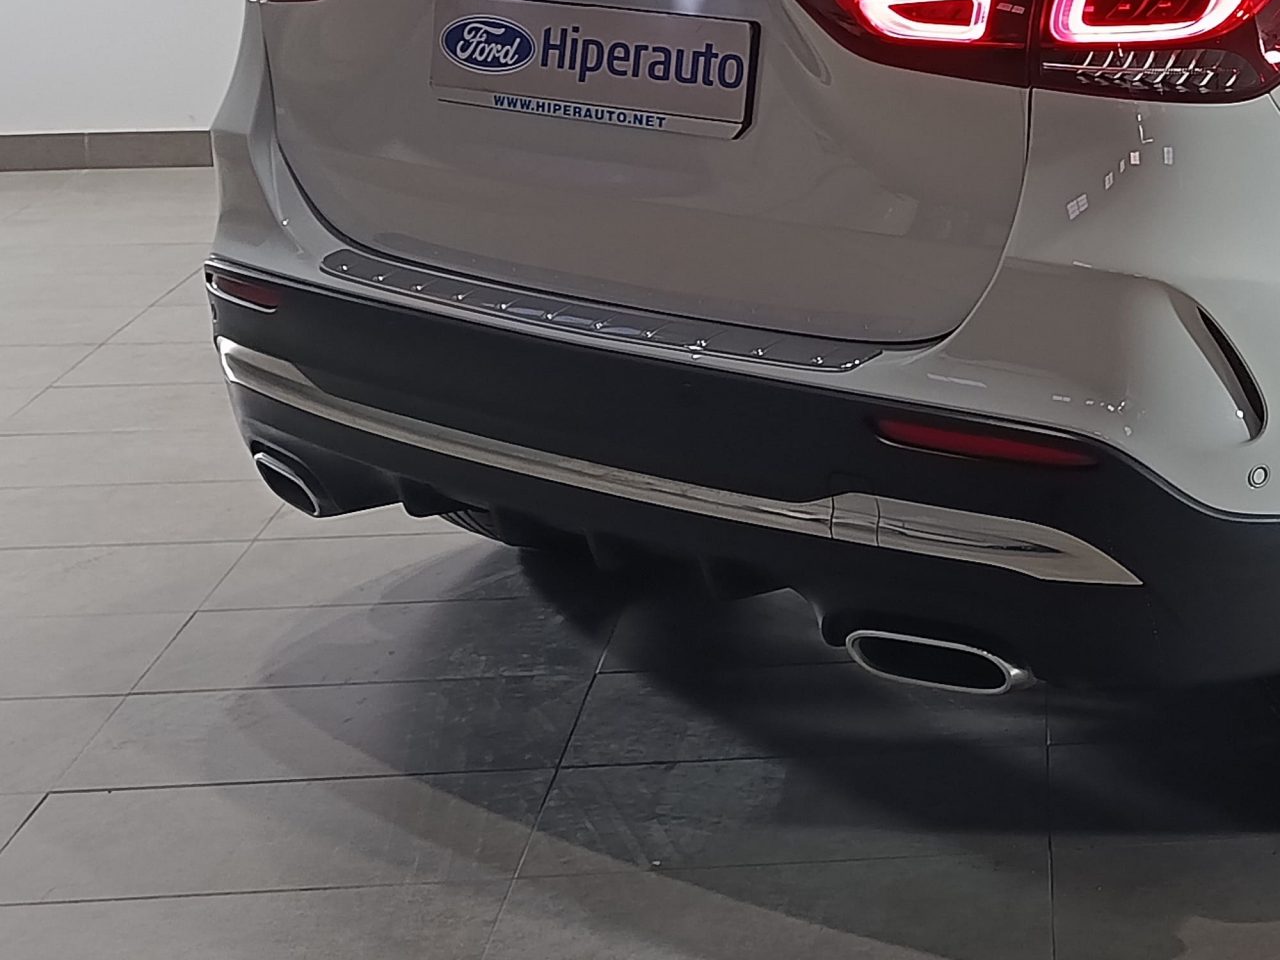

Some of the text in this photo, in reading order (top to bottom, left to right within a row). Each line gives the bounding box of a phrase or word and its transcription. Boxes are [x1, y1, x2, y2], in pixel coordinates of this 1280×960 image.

[456, 23, 521, 64] Ford
[540, 26, 744, 89] Hiperauto
[493, 94, 667, 129] WWW.HIPERAUTO.NET
